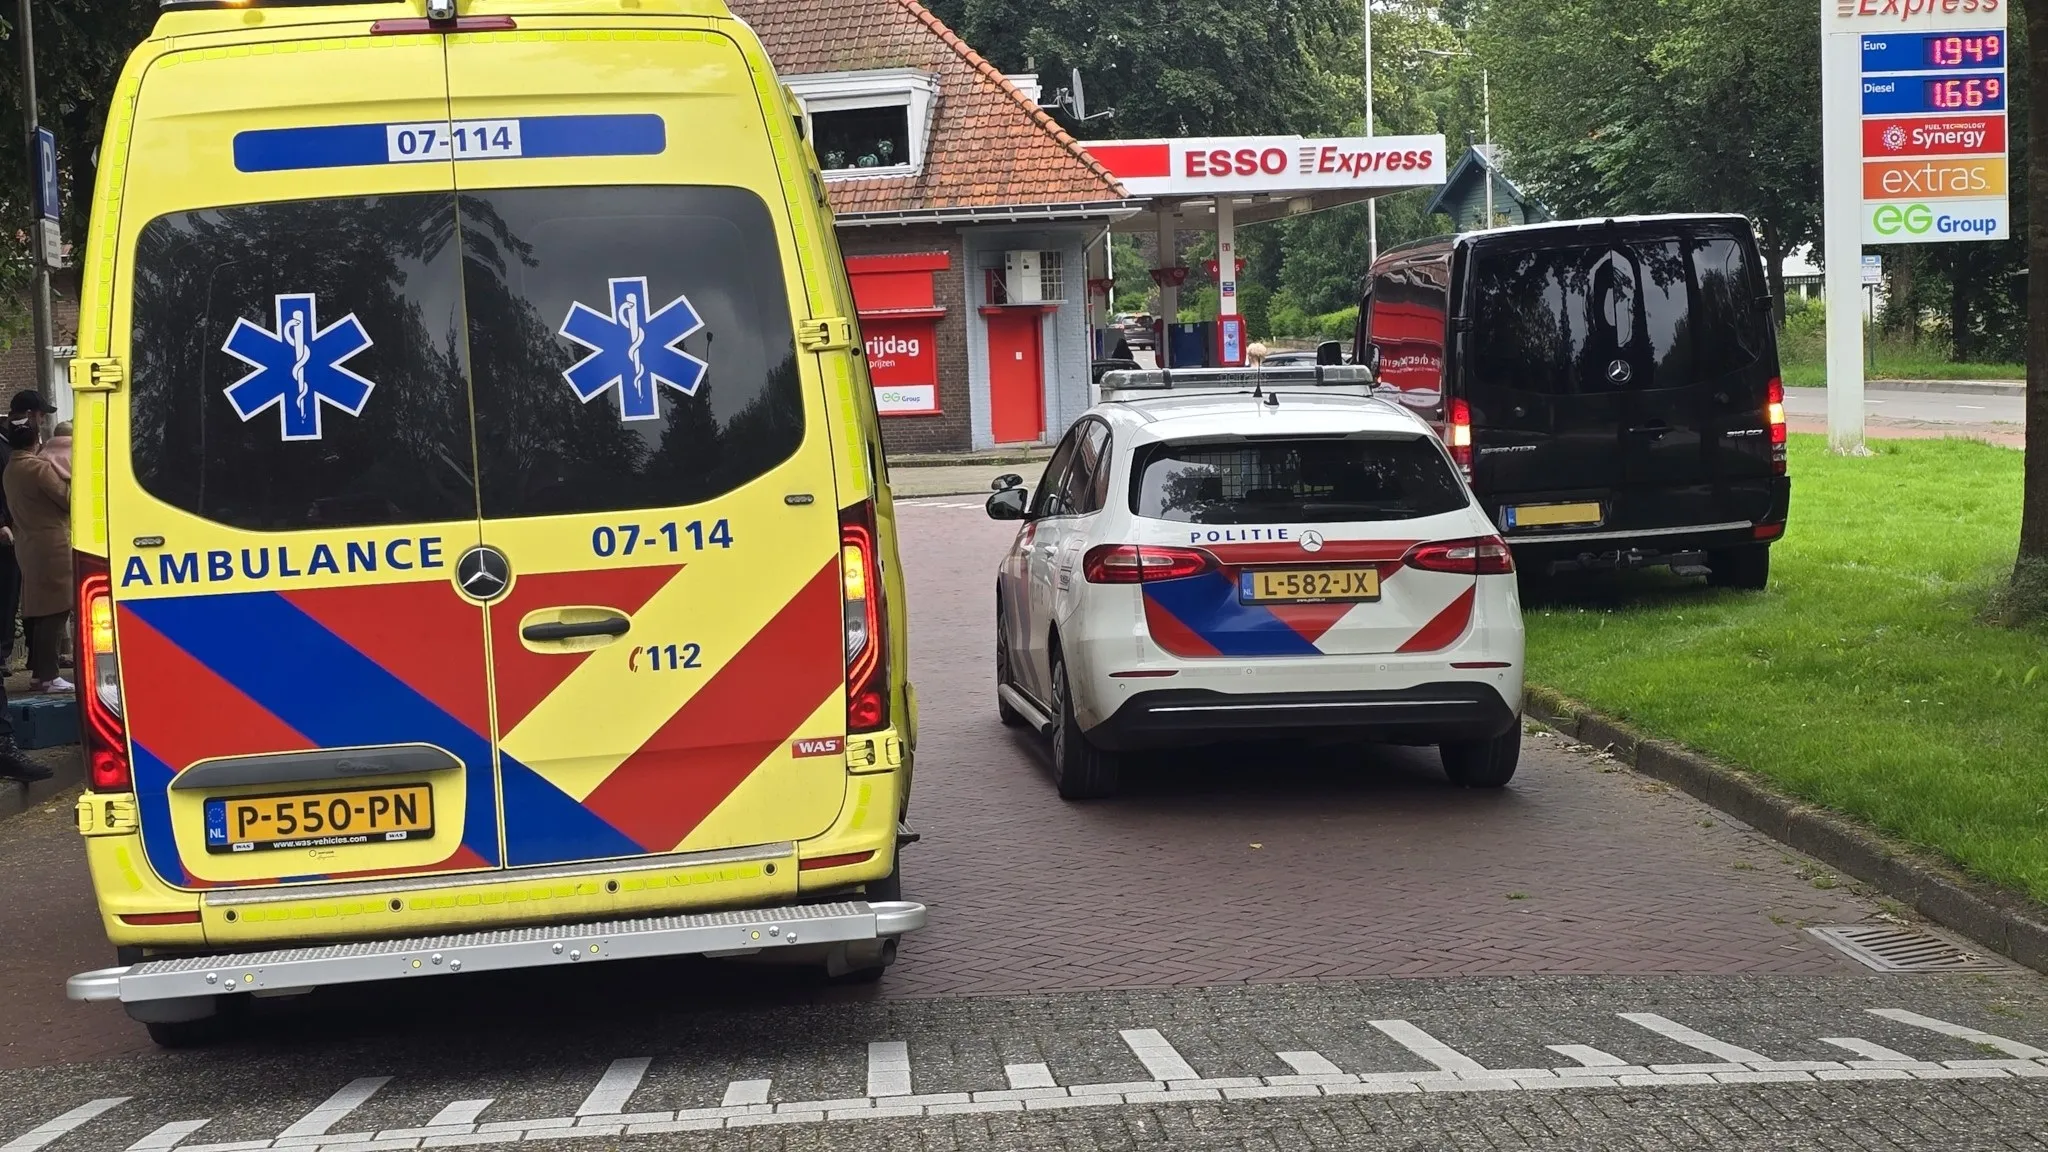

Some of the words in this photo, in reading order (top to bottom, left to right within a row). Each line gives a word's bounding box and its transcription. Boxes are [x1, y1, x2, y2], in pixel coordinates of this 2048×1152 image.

[1863, 41, 1887, 50] Euro
[1933, 36, 2000, 65] 1.949
[1863, 82, 1895, 93] Diesel
[1933, 79, 2000, 108] 1.669
[1924, 123, 1941, 131] FUEL
[1942, 122, 1986, 130] TECHNOLOGY
[397, 126, 513, 155] 07-114
[1912, 129, 1986, 149] Synergy
[1185, 147, 1288, 178] ESSO
[1317, 146, 1433, 179] Express
[42, 141, 53, 207] P
[1882, 162, 1986, 193] extras
[1936, 215, 1997, 236] Group
[865, 335, 920, 358] rijdag
[1480, 445, 1537, 455] SPRINTER
[592, 518, 734, 558] 07-114
[1190, 528, 1289, 543] POLITIE
[121, 536, 445, 588] AMBULANCE
[1243, 588, 1253, 596] NL
[1264, 572, 1369, 596] L-582-JX
[799, 740, 837, 754] WAS
[237, 793, 418, 839] P-550-PN
[209, 828, 226, 839] NL
[272, 834, 368, 849] www.was-vehicles.com
[387, 832, 405, 840] WAS
[236, 843, 252, 851] WAS
